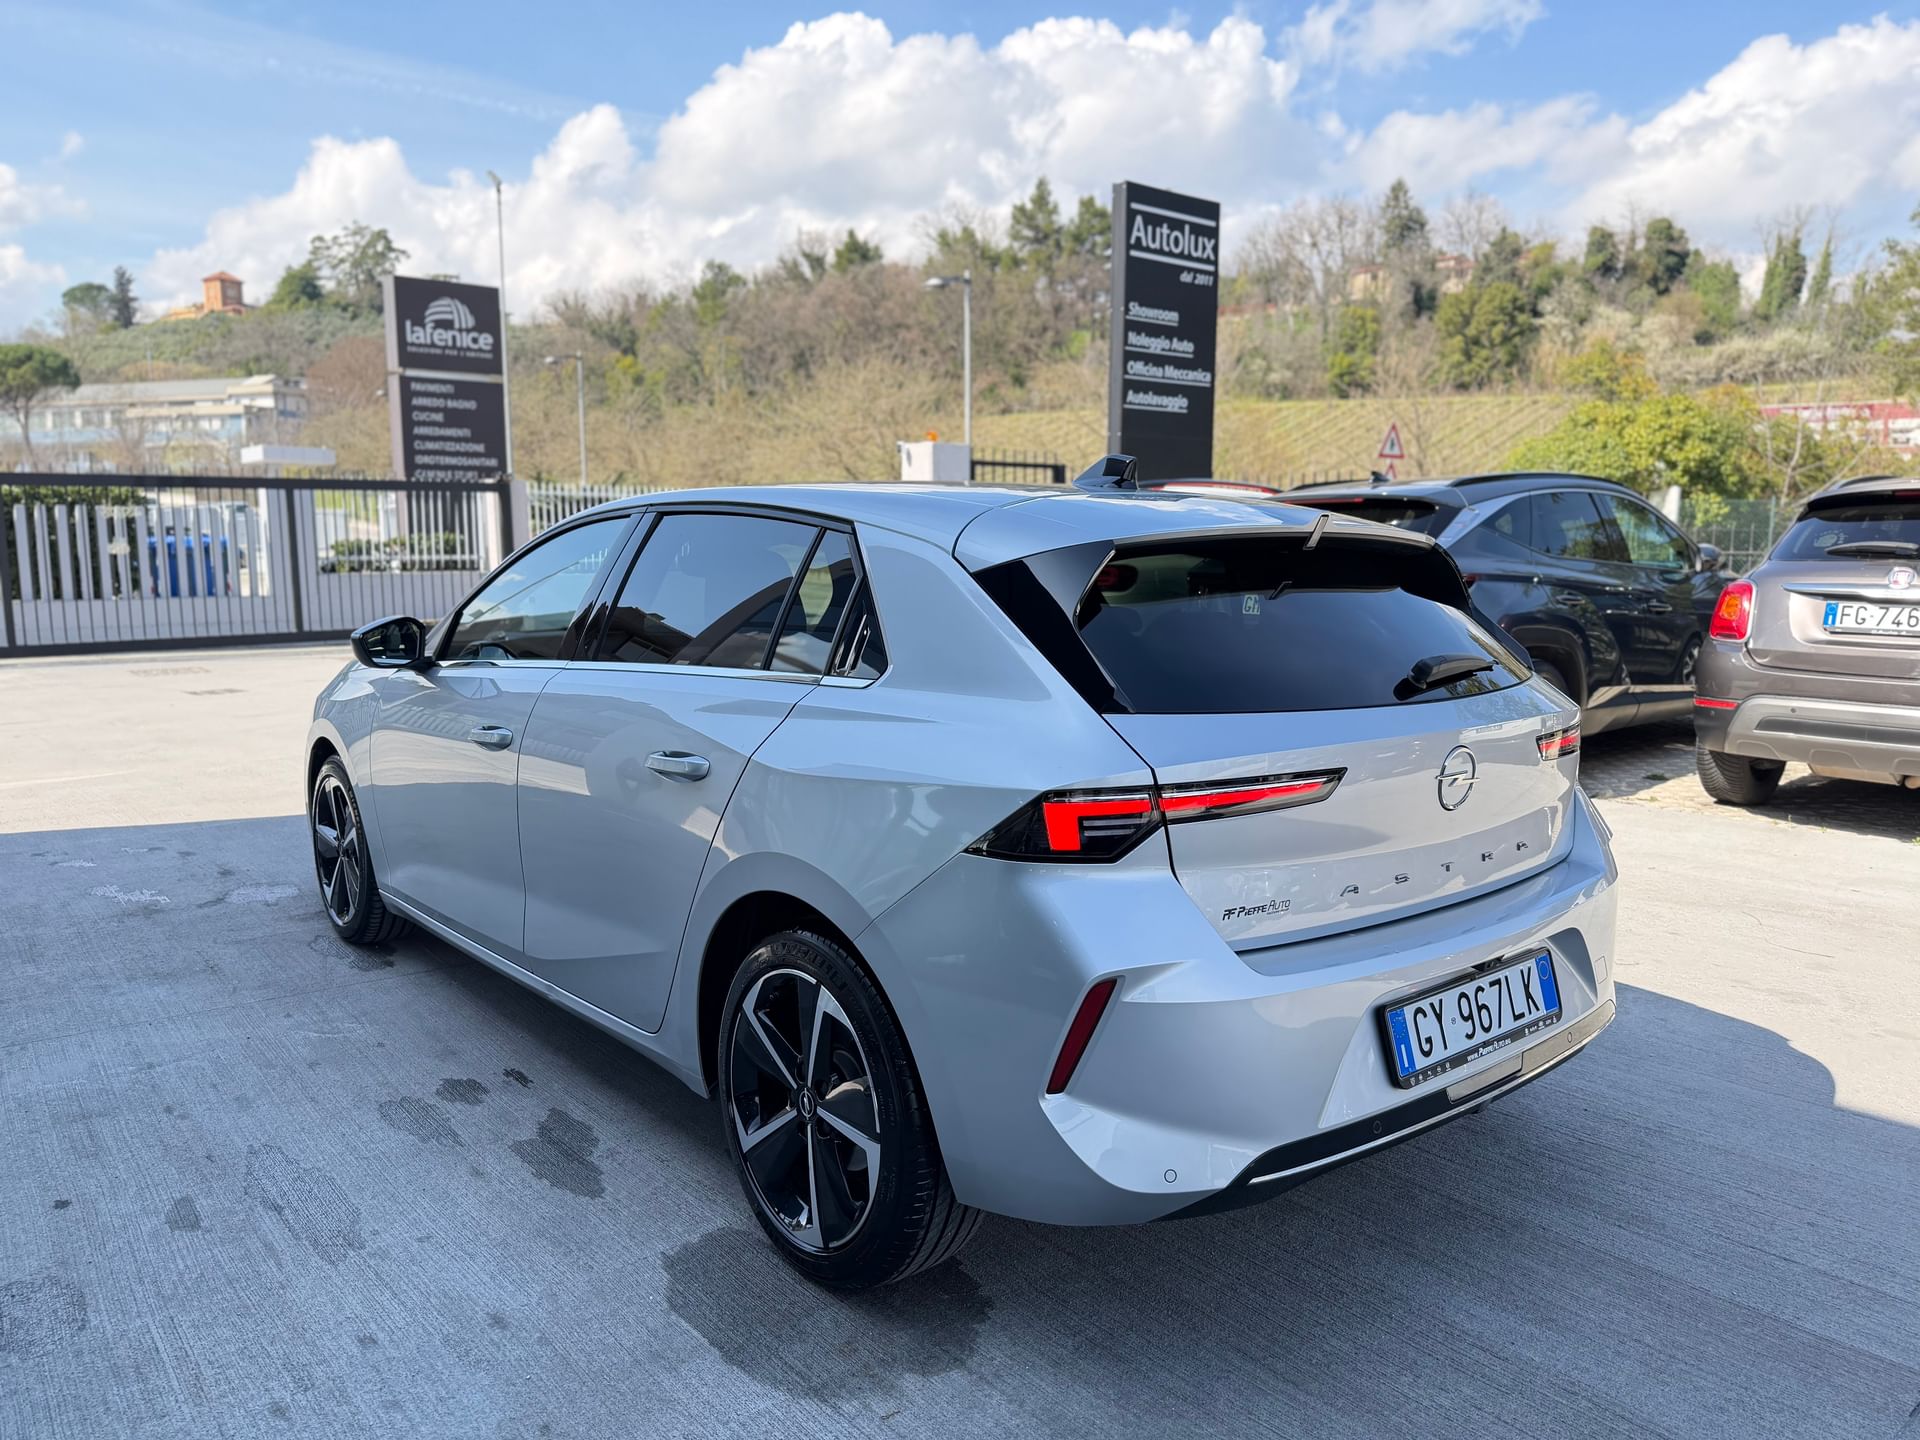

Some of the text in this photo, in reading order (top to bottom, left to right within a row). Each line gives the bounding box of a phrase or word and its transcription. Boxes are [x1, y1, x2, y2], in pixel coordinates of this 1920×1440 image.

[1130, 214, 1216, 261] Autolux
[1179, 270, 1214, 287] dal 2011
[1128, 301, 1179, 321] Showroom
[404, 319, 494, 351] lafenice
[1127, 331, 1195, 353] Noleggio Auto
[1126, 360, 1212, 383] Officina Meccanica
[410, 381, 455, 394] PAVIMENTI
[411, 396, 478, 411] ARREDO BAGNO
[1126, 389, 1189, 411] Autolavaggio
[412, 411, 444, 423] CUCINE
[413, 426, 472, 438] ARREDAMENTI
[414, 440, 485, 453] CLIMATIZZAZIONE
[415, 454, 498, 468] IDROTERMOSANITARI
[1340, 840, 1529, 898] ASTRA
[1413, 998, 1449, 1058] GY
[1457, 966, 1541, 1041] 967LK
